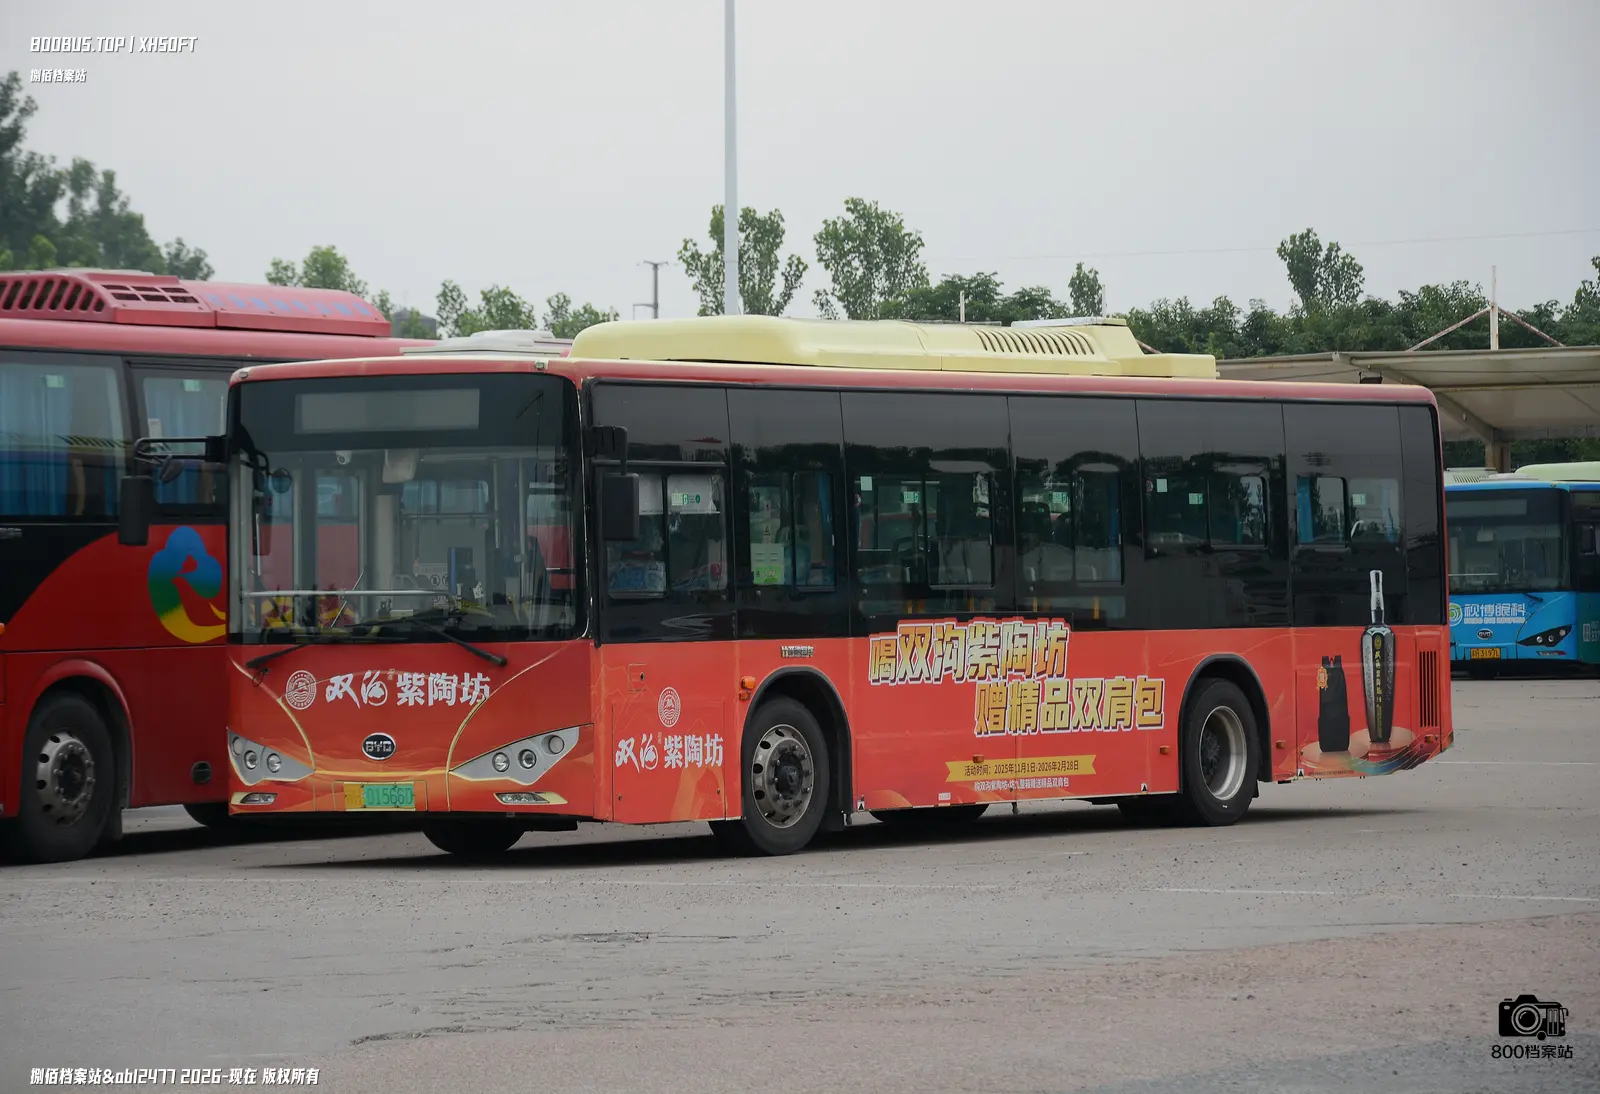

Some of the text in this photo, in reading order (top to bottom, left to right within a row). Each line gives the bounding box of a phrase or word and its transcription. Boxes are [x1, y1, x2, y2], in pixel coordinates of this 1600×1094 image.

[1464, 603, 1526, 617] 视博眼科
[868, 619, 1071, 686] 喝双沟紫陶坊
[974, 675, 1166, 738] 赠精品双肩包
[365, 740, 392, 752] BYD
